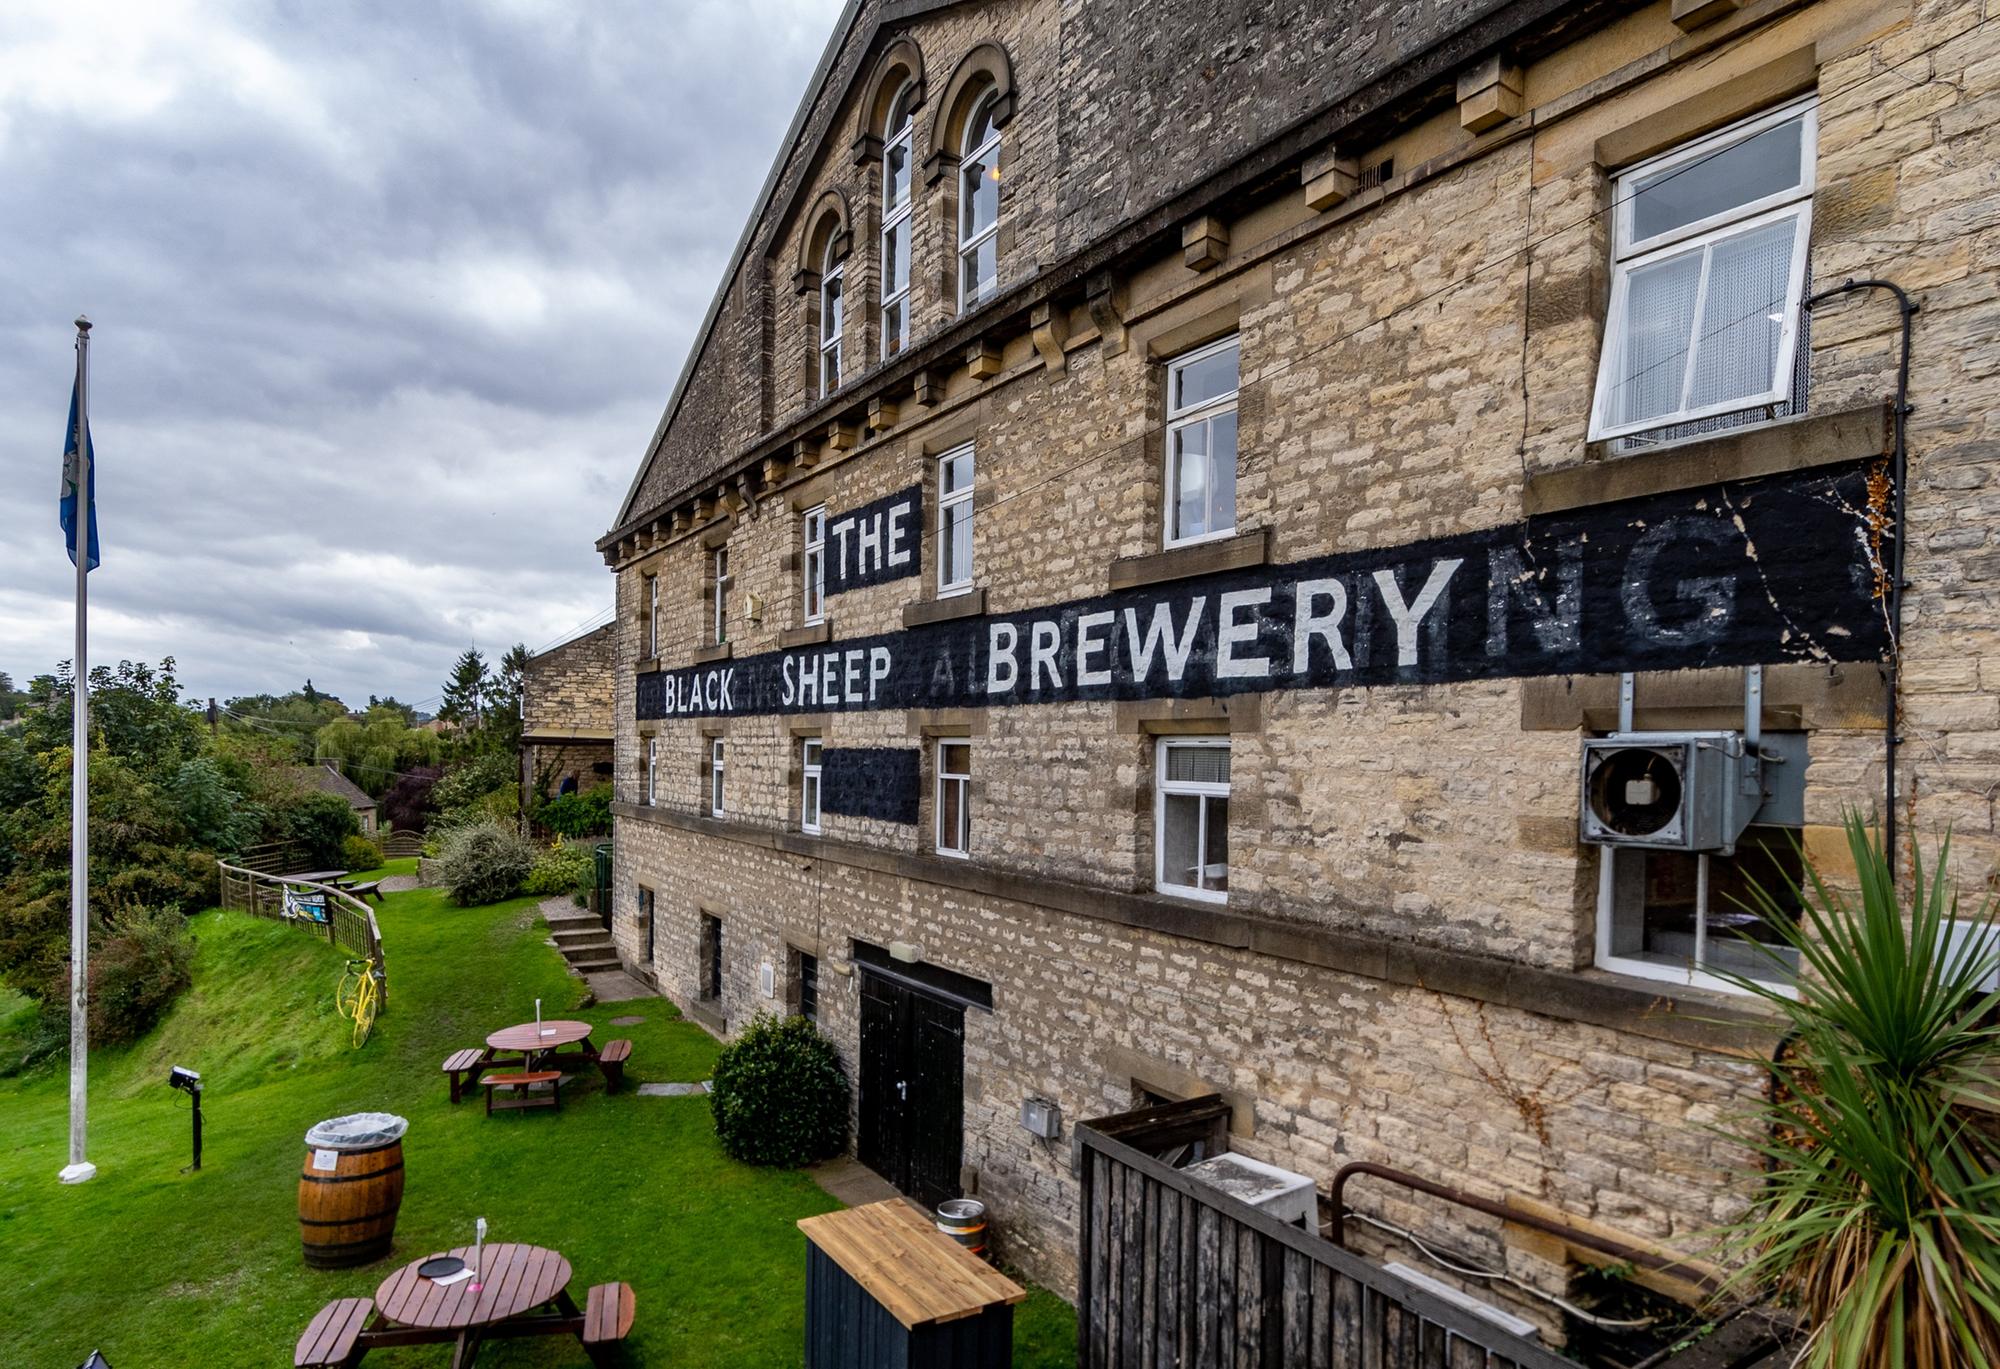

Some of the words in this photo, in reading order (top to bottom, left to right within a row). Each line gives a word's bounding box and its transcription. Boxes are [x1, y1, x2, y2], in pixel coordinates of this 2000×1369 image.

[832, 501, 911, 580] THE
[664, 667, 734, 714] BLACK
[781, 646, 892, 707] SHEEP
[985, 558, 1464, 696] BREWERY
